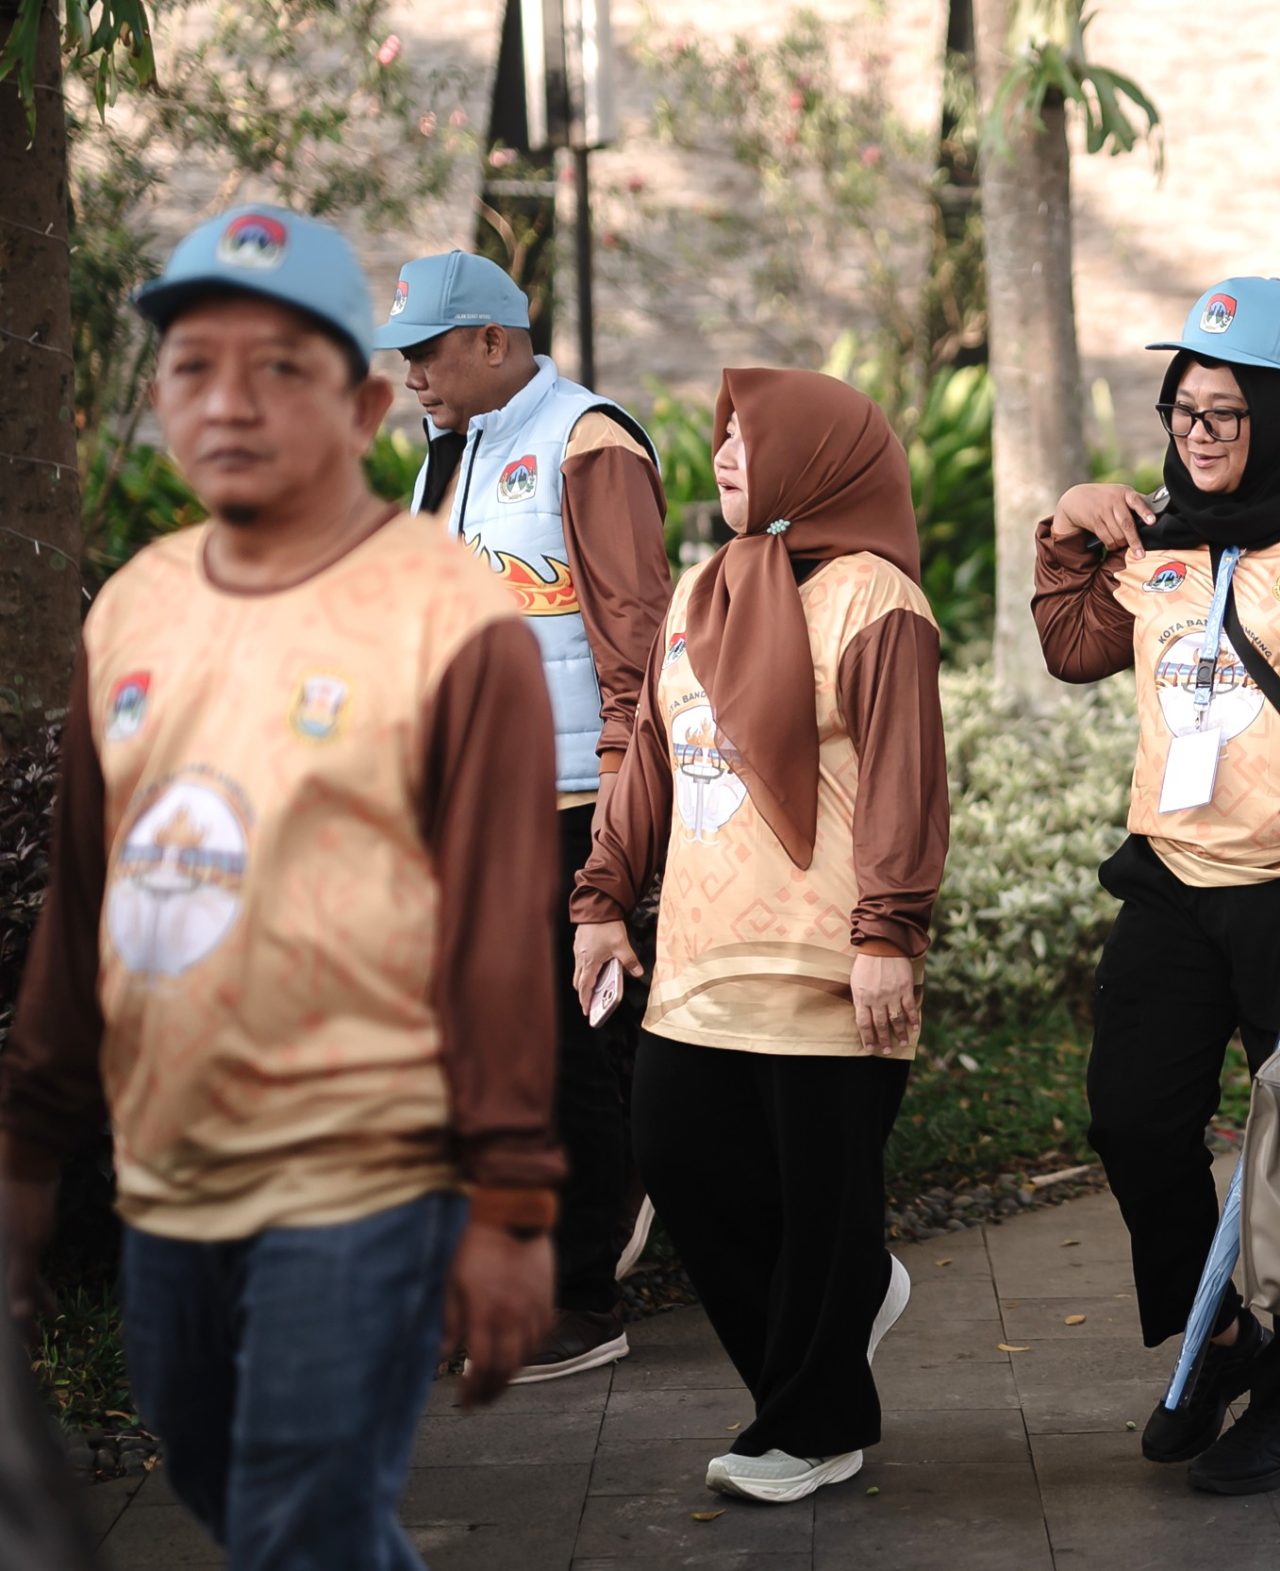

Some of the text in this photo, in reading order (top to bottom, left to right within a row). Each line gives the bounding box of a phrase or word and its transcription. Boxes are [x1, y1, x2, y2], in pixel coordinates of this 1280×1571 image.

[1158, 622, 1184, 645] KOTA
[1186, 618, 1208, 628] BAN
[682, 691, 706, 703] BAND
